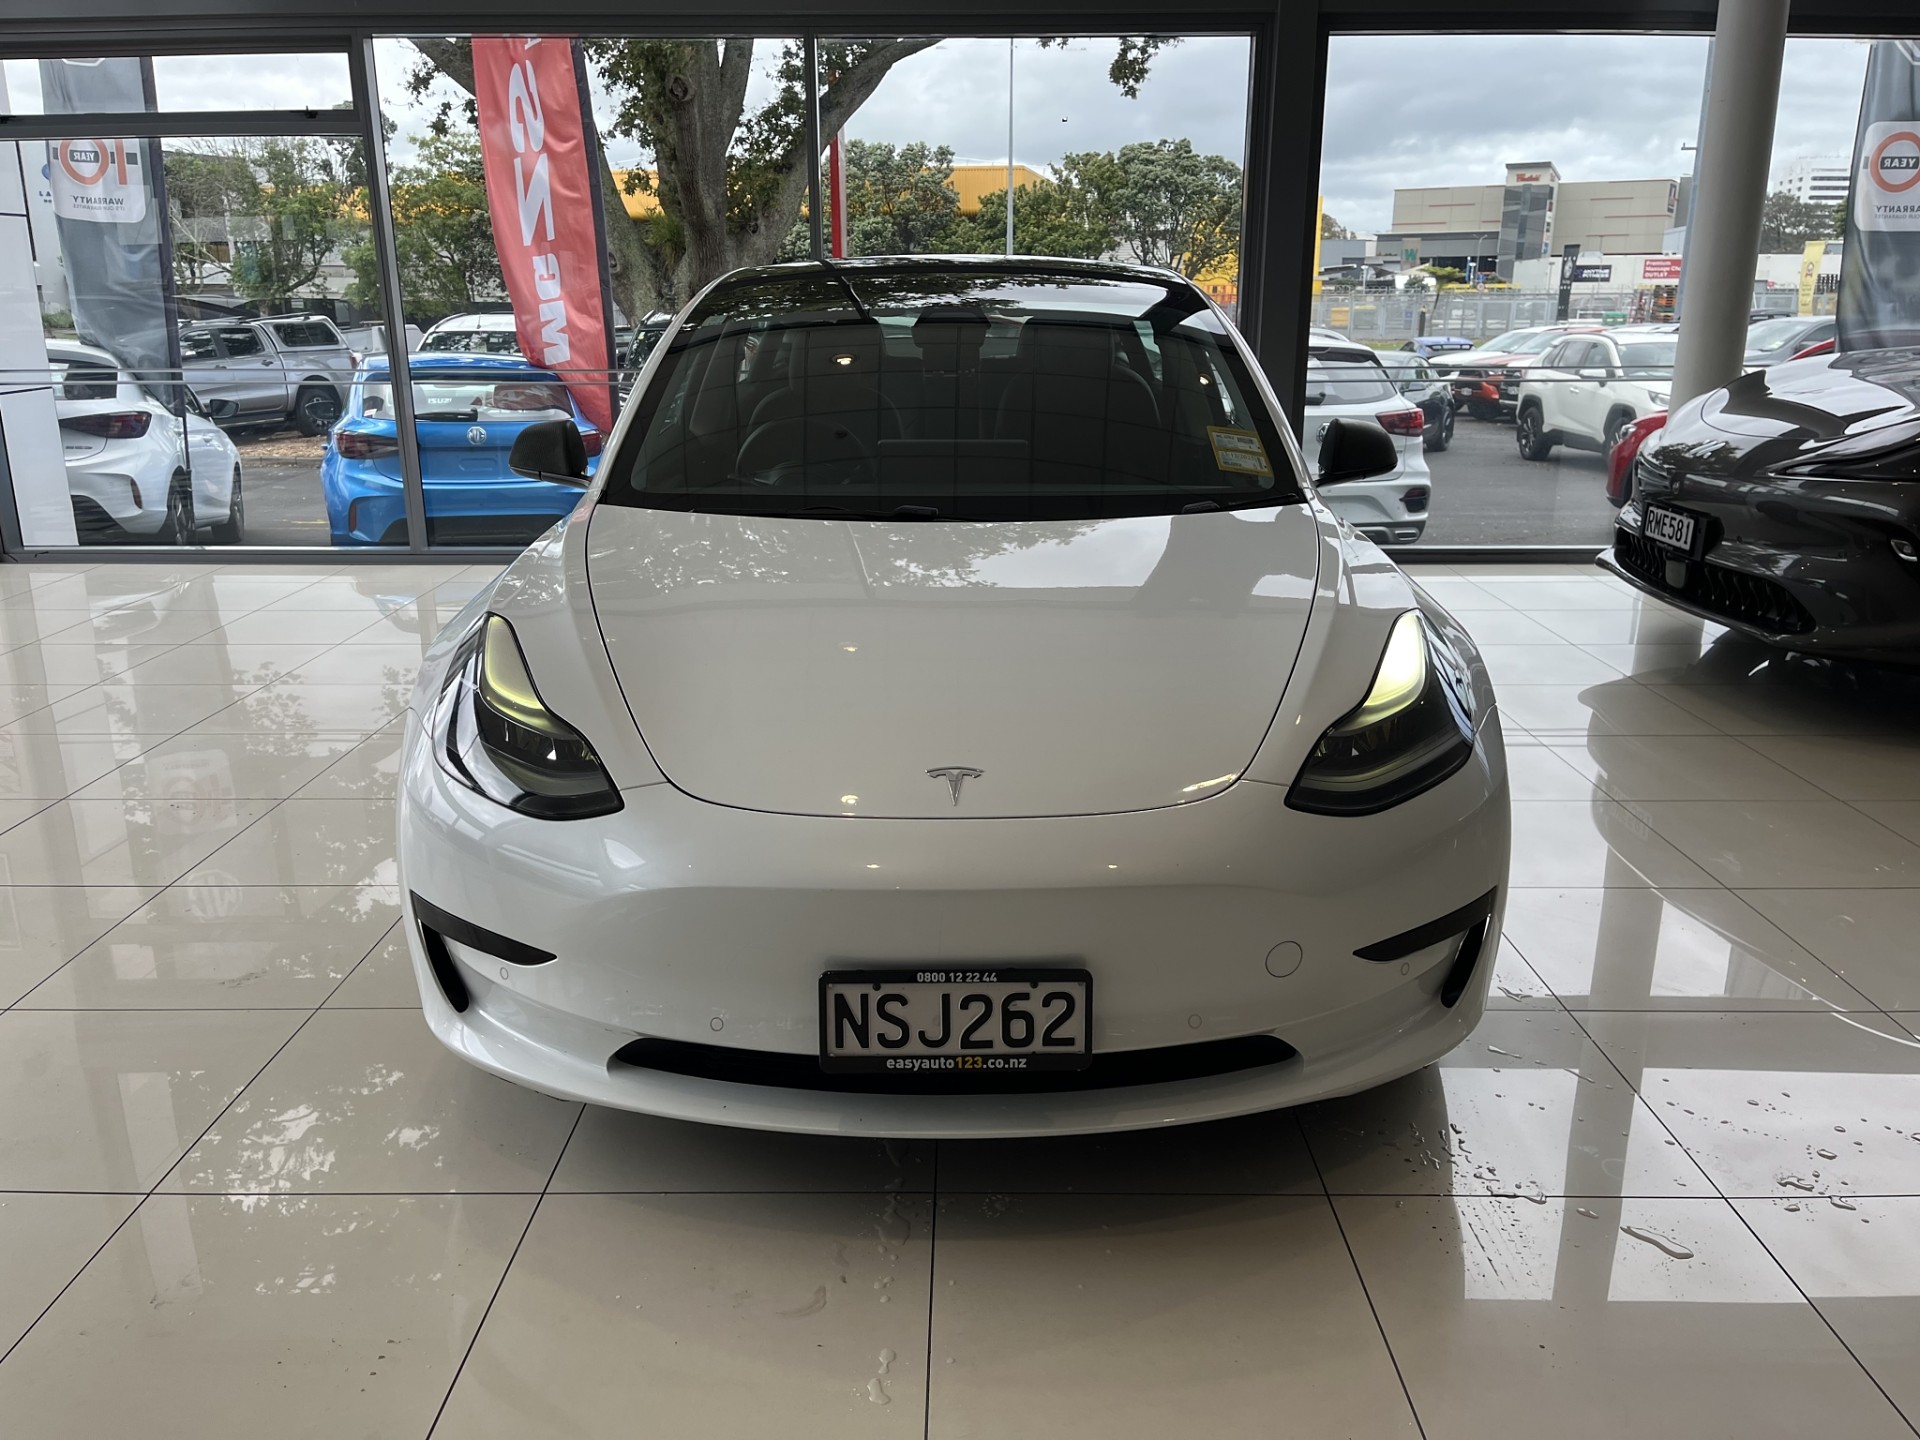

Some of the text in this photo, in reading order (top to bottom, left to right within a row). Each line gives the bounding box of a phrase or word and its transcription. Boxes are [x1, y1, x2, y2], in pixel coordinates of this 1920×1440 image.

[1646, 509, 1691, 545] RME581
[917, 972, 998, 983] 0800 12 22 44
[834, 991, 1077, 1050] NSJ262
[886, 1056, 1027, 1072] easyauto123.co.nz
